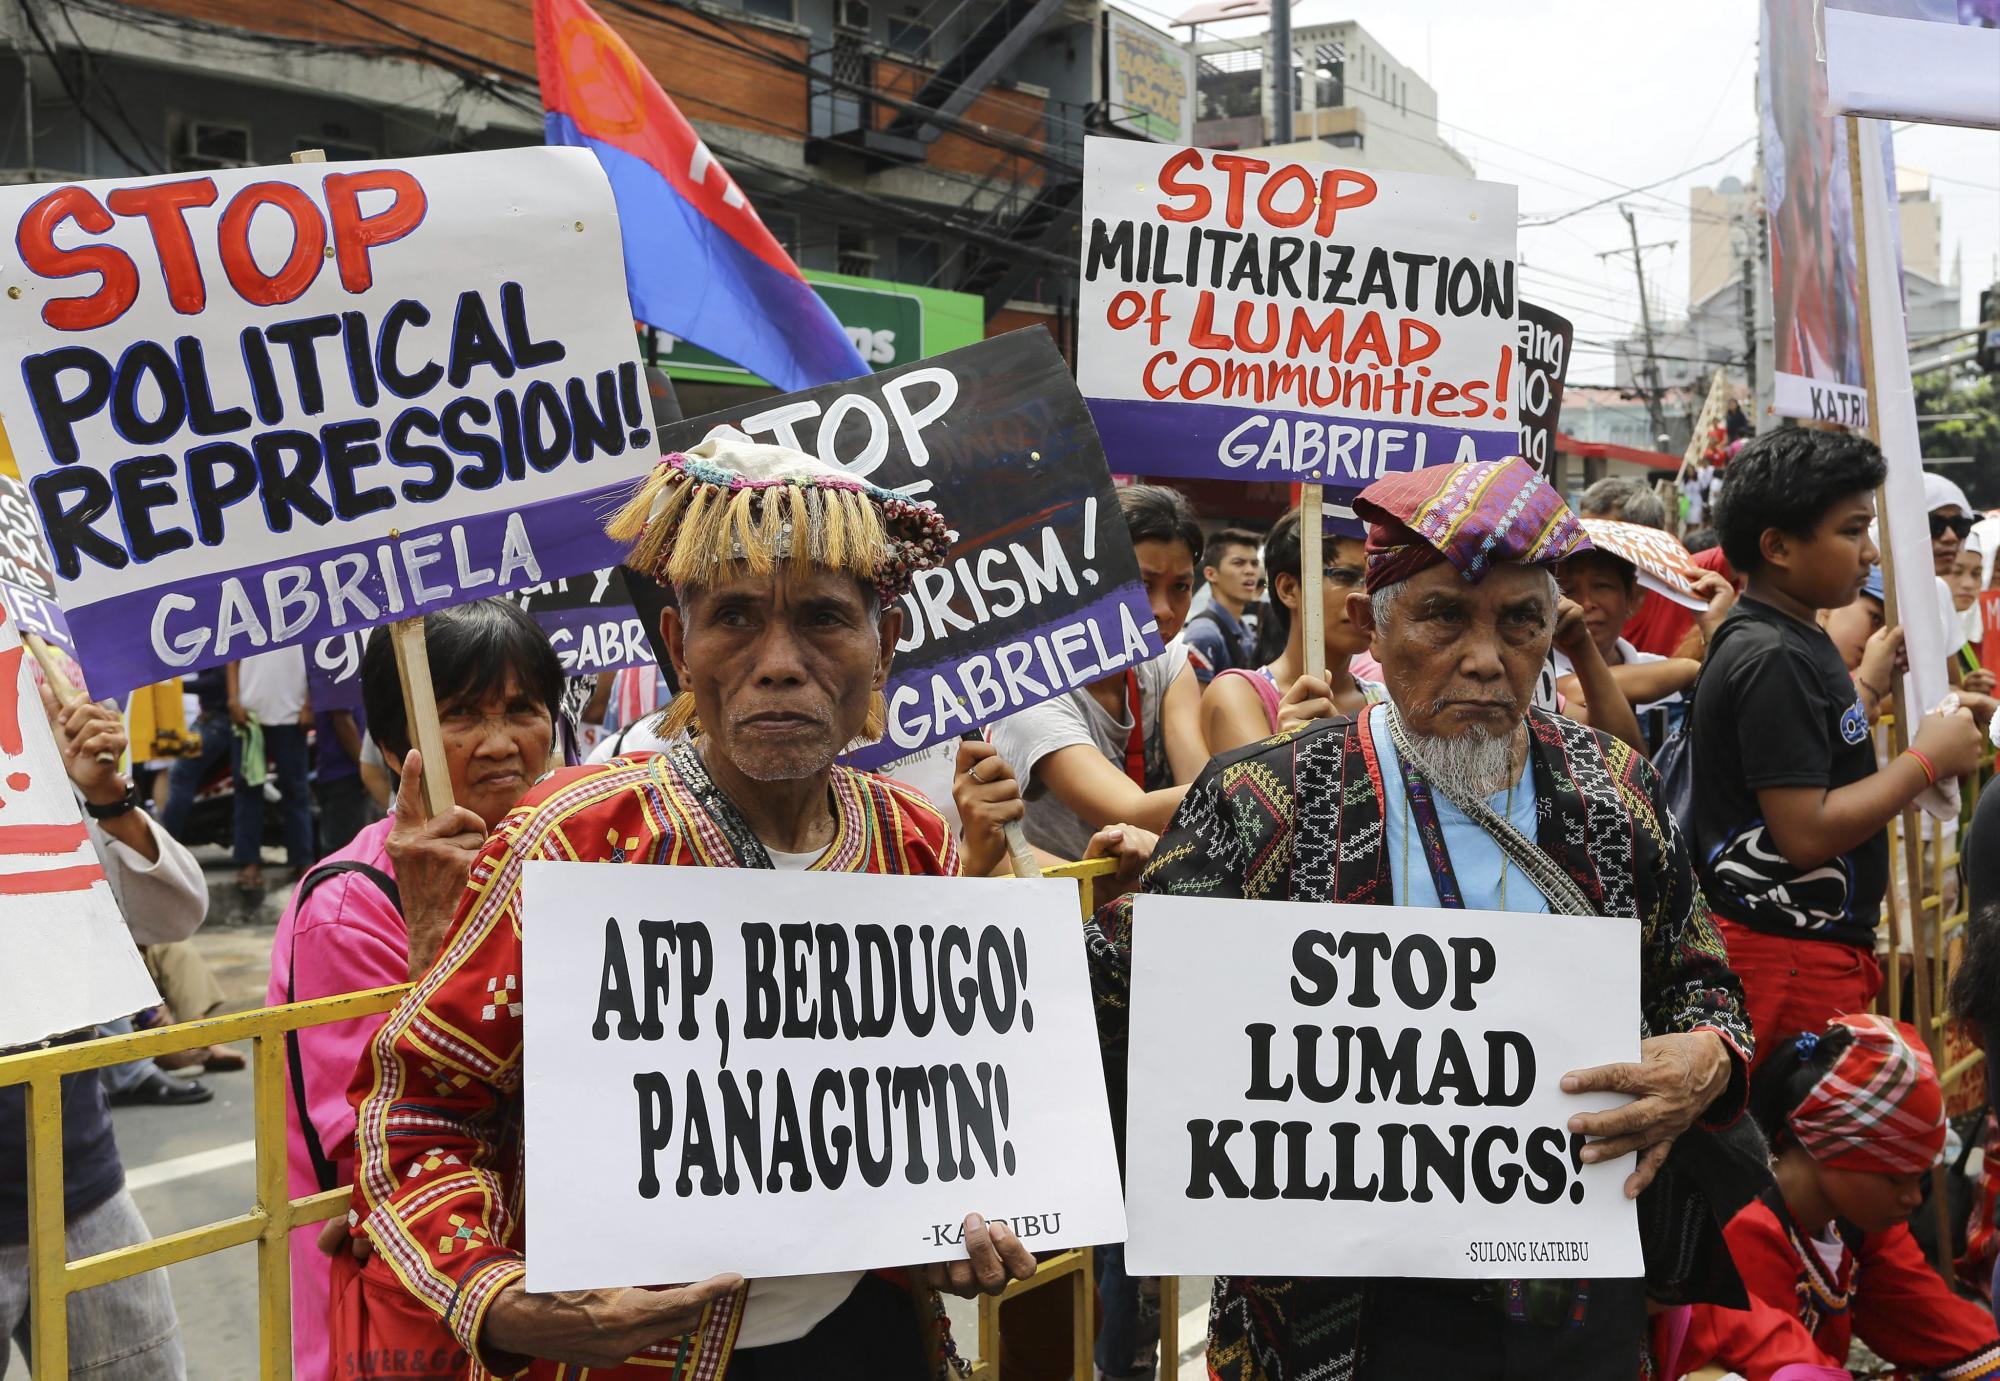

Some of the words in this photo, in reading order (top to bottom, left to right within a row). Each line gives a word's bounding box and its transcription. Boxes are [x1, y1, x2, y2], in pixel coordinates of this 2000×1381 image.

[1157, 148, 1377, 238] STOP
[15, 169, 428, 332] STOP
[1085, 218, 1514, 320] MILITARIZATION
[22, 282, 565, 466] POLITICAL
[1189, 291, 1441, 367] LUMAD
[28, 361, 651, 581] REPRESSION!
[150, 513, 541, 668] GABRIELA
[591, 916, 730, 1069] AFP,
[740, 920, 1034, 1041] BERDUGO!
[1290, 929, 1497, 1011] STOP
[1244, 1022, 1537, 1107] LUMAD
[633, 1061, 1016, 1199] PANAGUTIN!
[1185, 1119, 1585, 1205] KILLINGS!
[1466, 1241, 1527, 1263] -SULONG
[1528, 1241, 1589, 1262] KATRIBU
